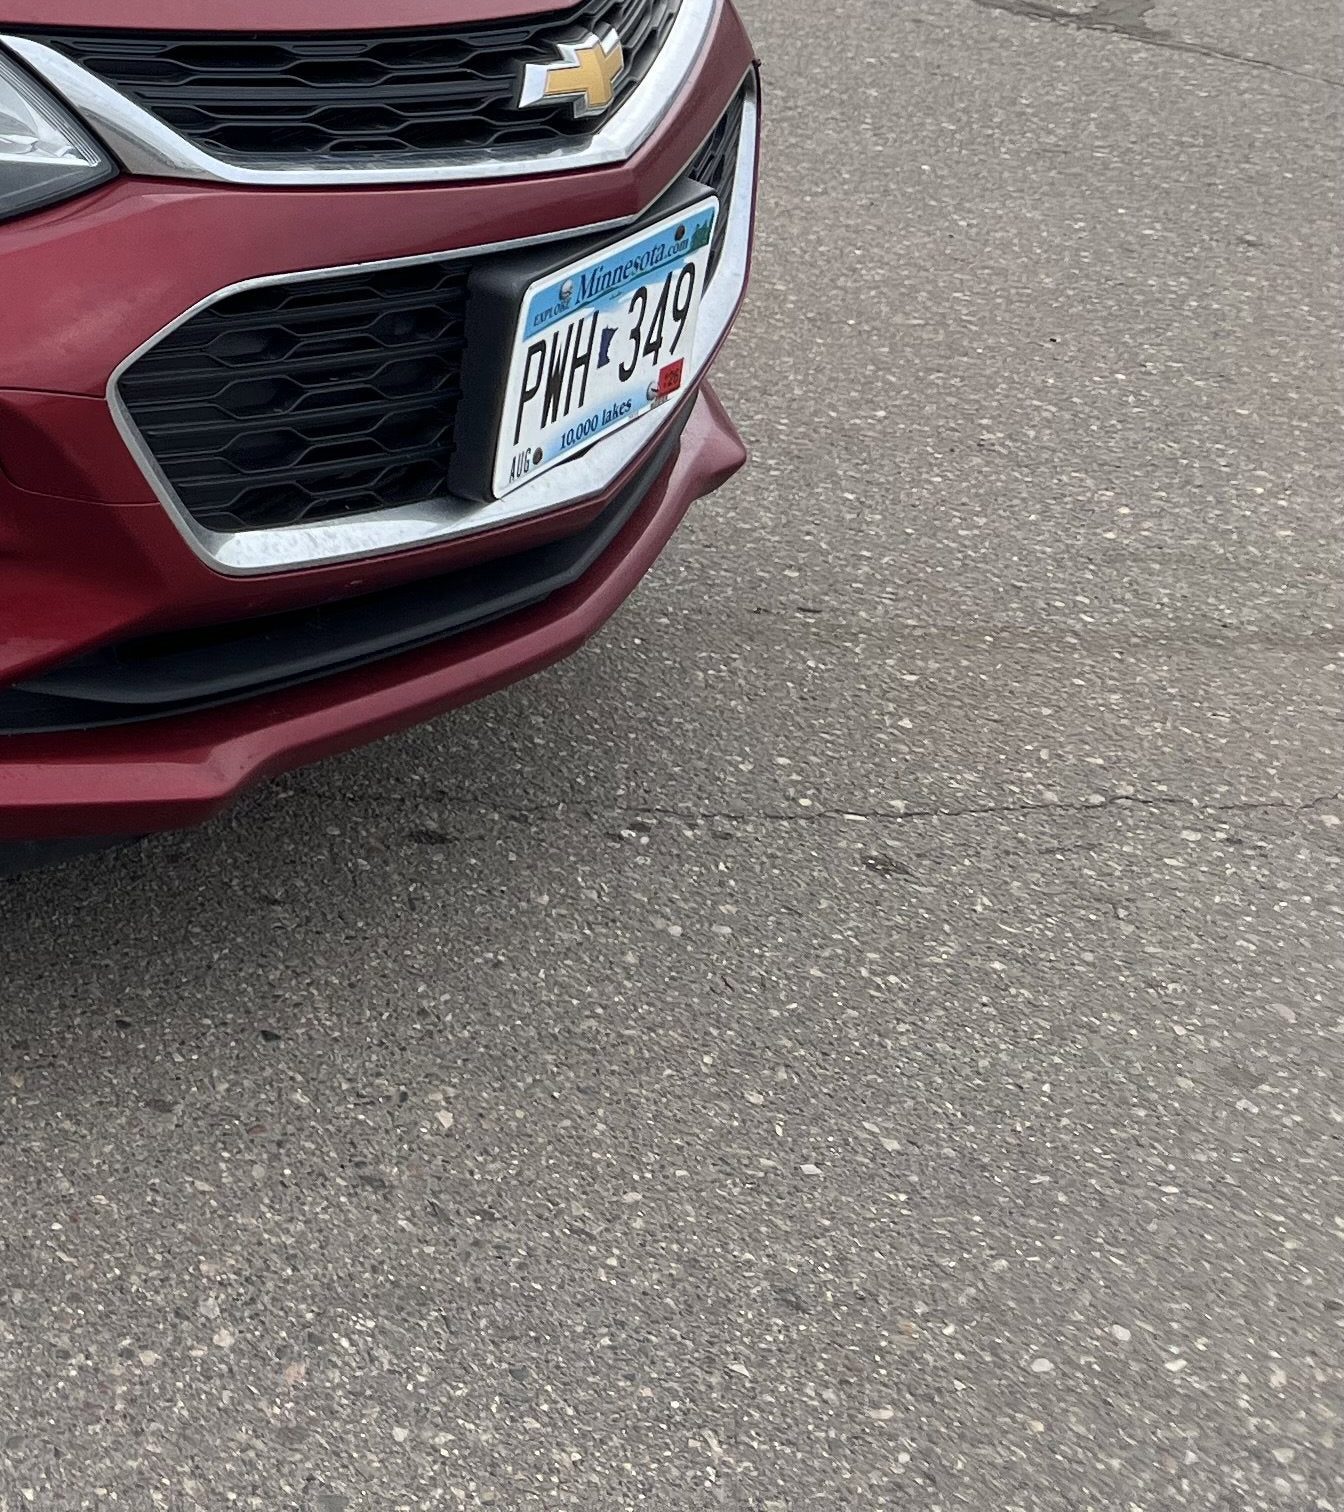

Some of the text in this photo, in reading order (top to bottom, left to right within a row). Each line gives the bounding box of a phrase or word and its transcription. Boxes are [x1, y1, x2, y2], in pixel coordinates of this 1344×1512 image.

[513, 262, 696, 446] PWH 349
[560, 398, 632, 451] 10,000 lakes
[509, 447, 532, 484] AUG
